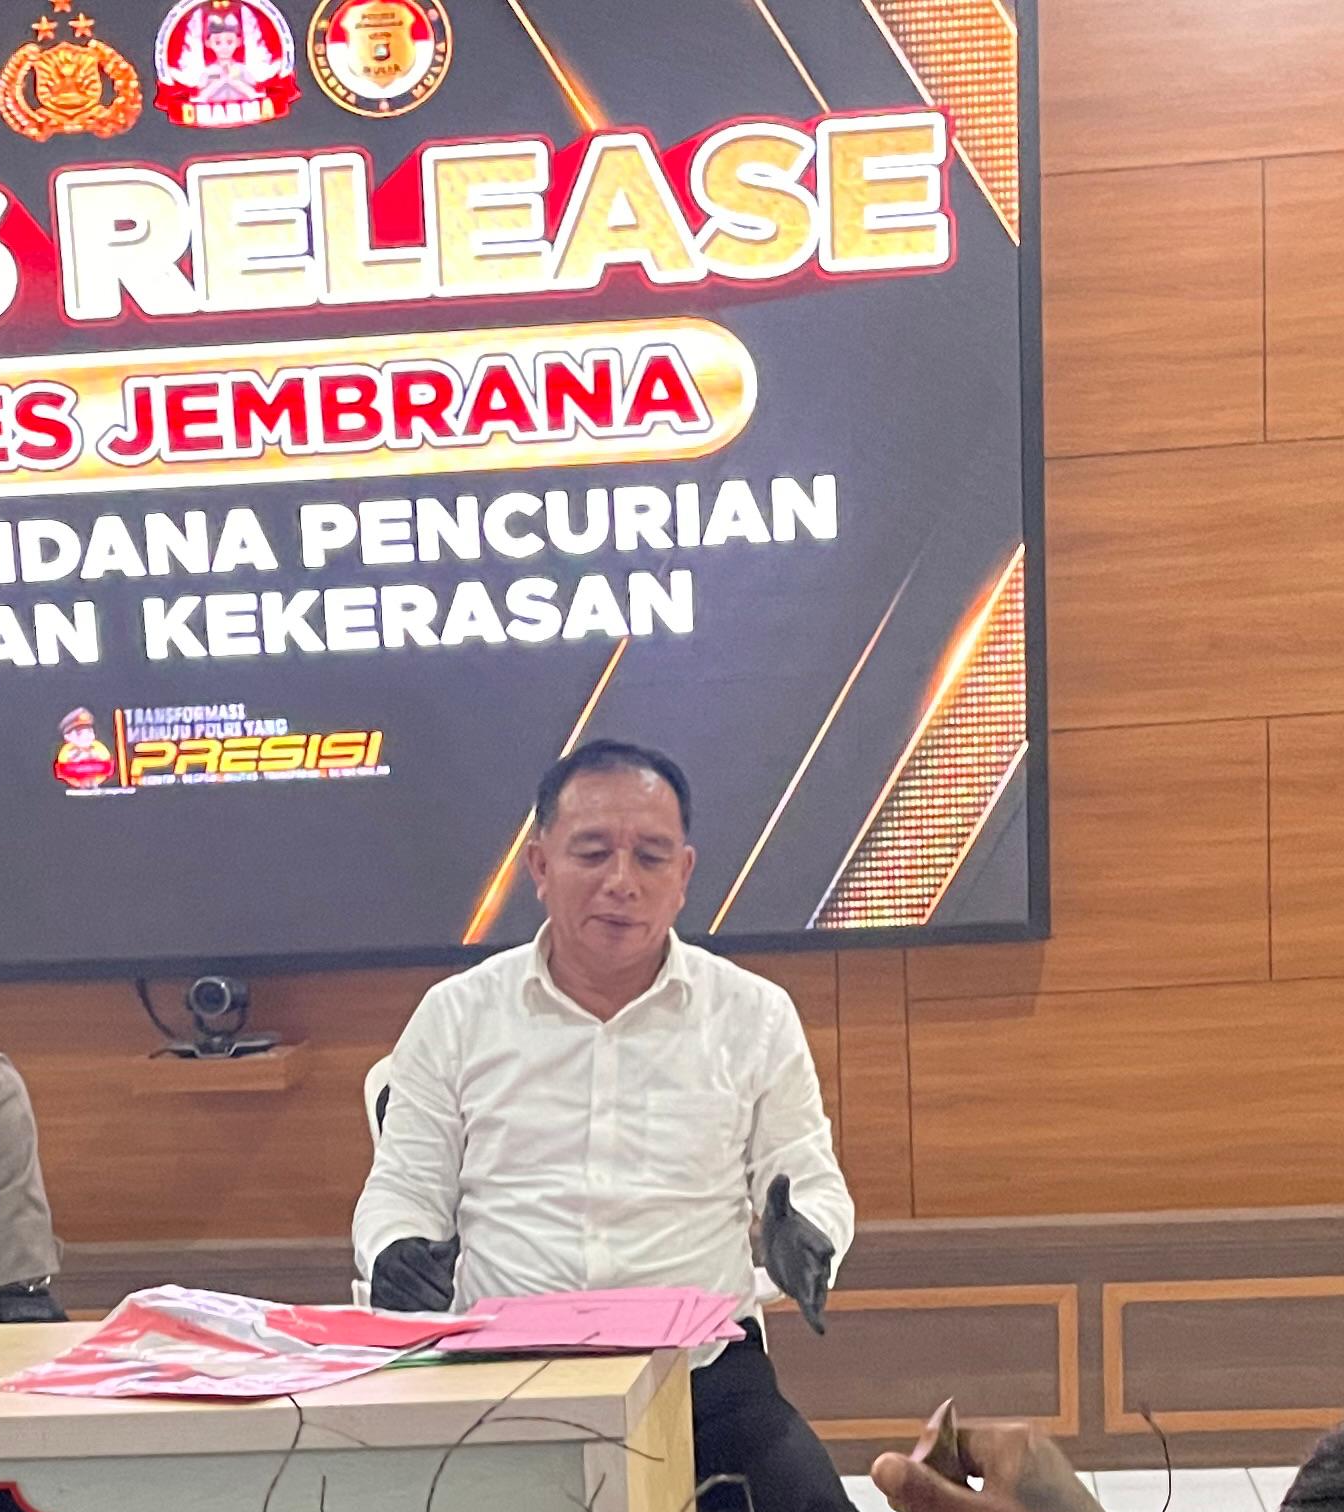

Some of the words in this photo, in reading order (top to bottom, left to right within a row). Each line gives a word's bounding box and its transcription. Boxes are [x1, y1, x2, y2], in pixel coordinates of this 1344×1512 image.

[58, 112, 949, 324] RELEASE
[103, 347, 706, 462] JEMBRANA
[300, 474, 839, 568] PENCURIAN
[143, 569, 695, 660] KEKERASAN
[125, 703, 246, 725] TRANSFORMASI
[130, 730, 384, 775] PRESISI
